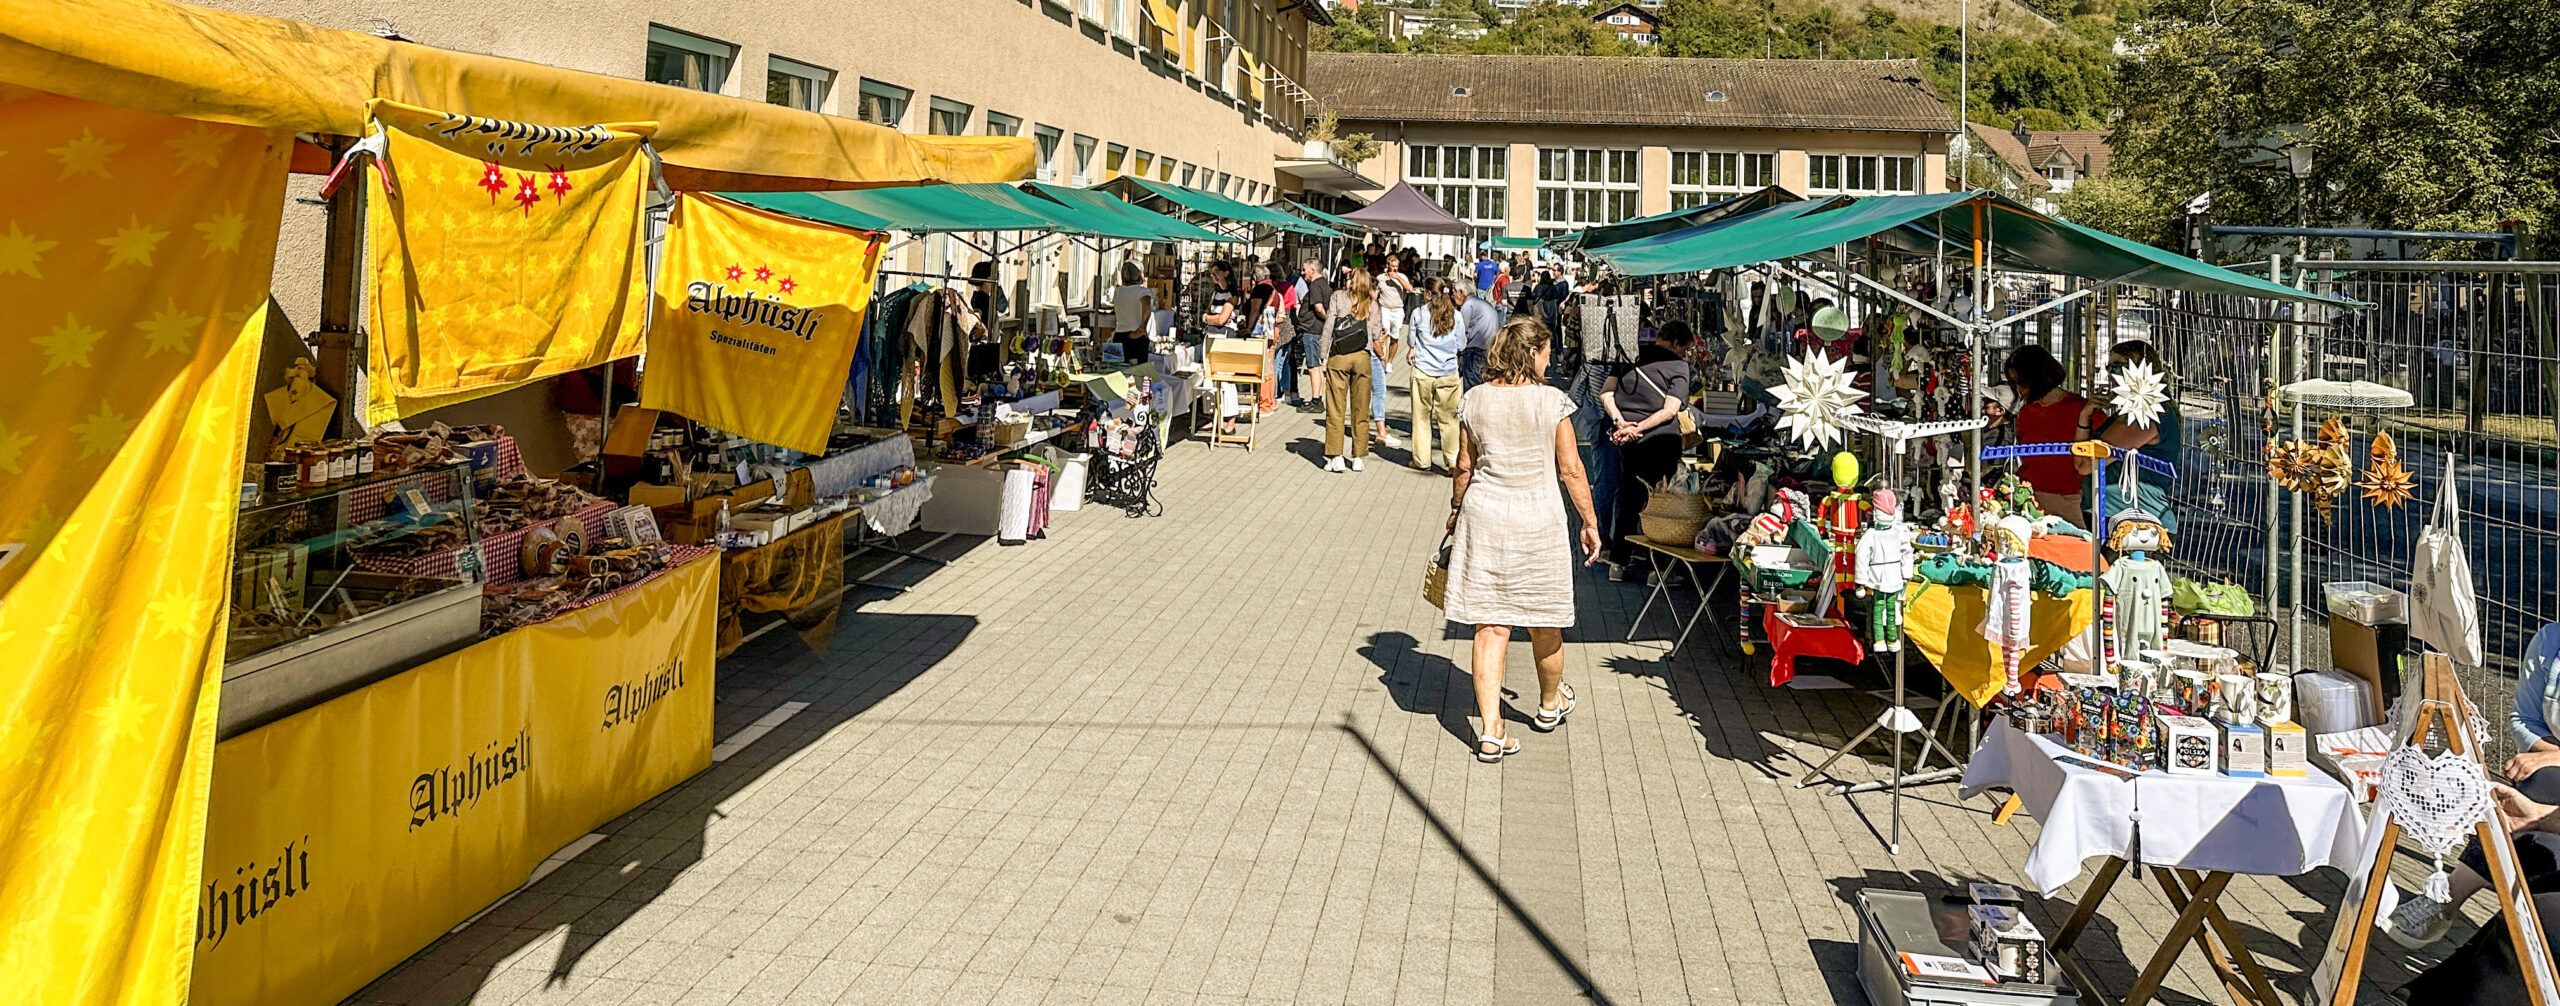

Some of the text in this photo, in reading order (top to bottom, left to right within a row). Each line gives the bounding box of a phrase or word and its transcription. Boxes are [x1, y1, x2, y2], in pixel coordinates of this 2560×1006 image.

[687, 281, 823, 342] Alphüsli
[709, 330, 777, 356] Spezialitäten
[601, 650, 685, 733] Alphüsli
